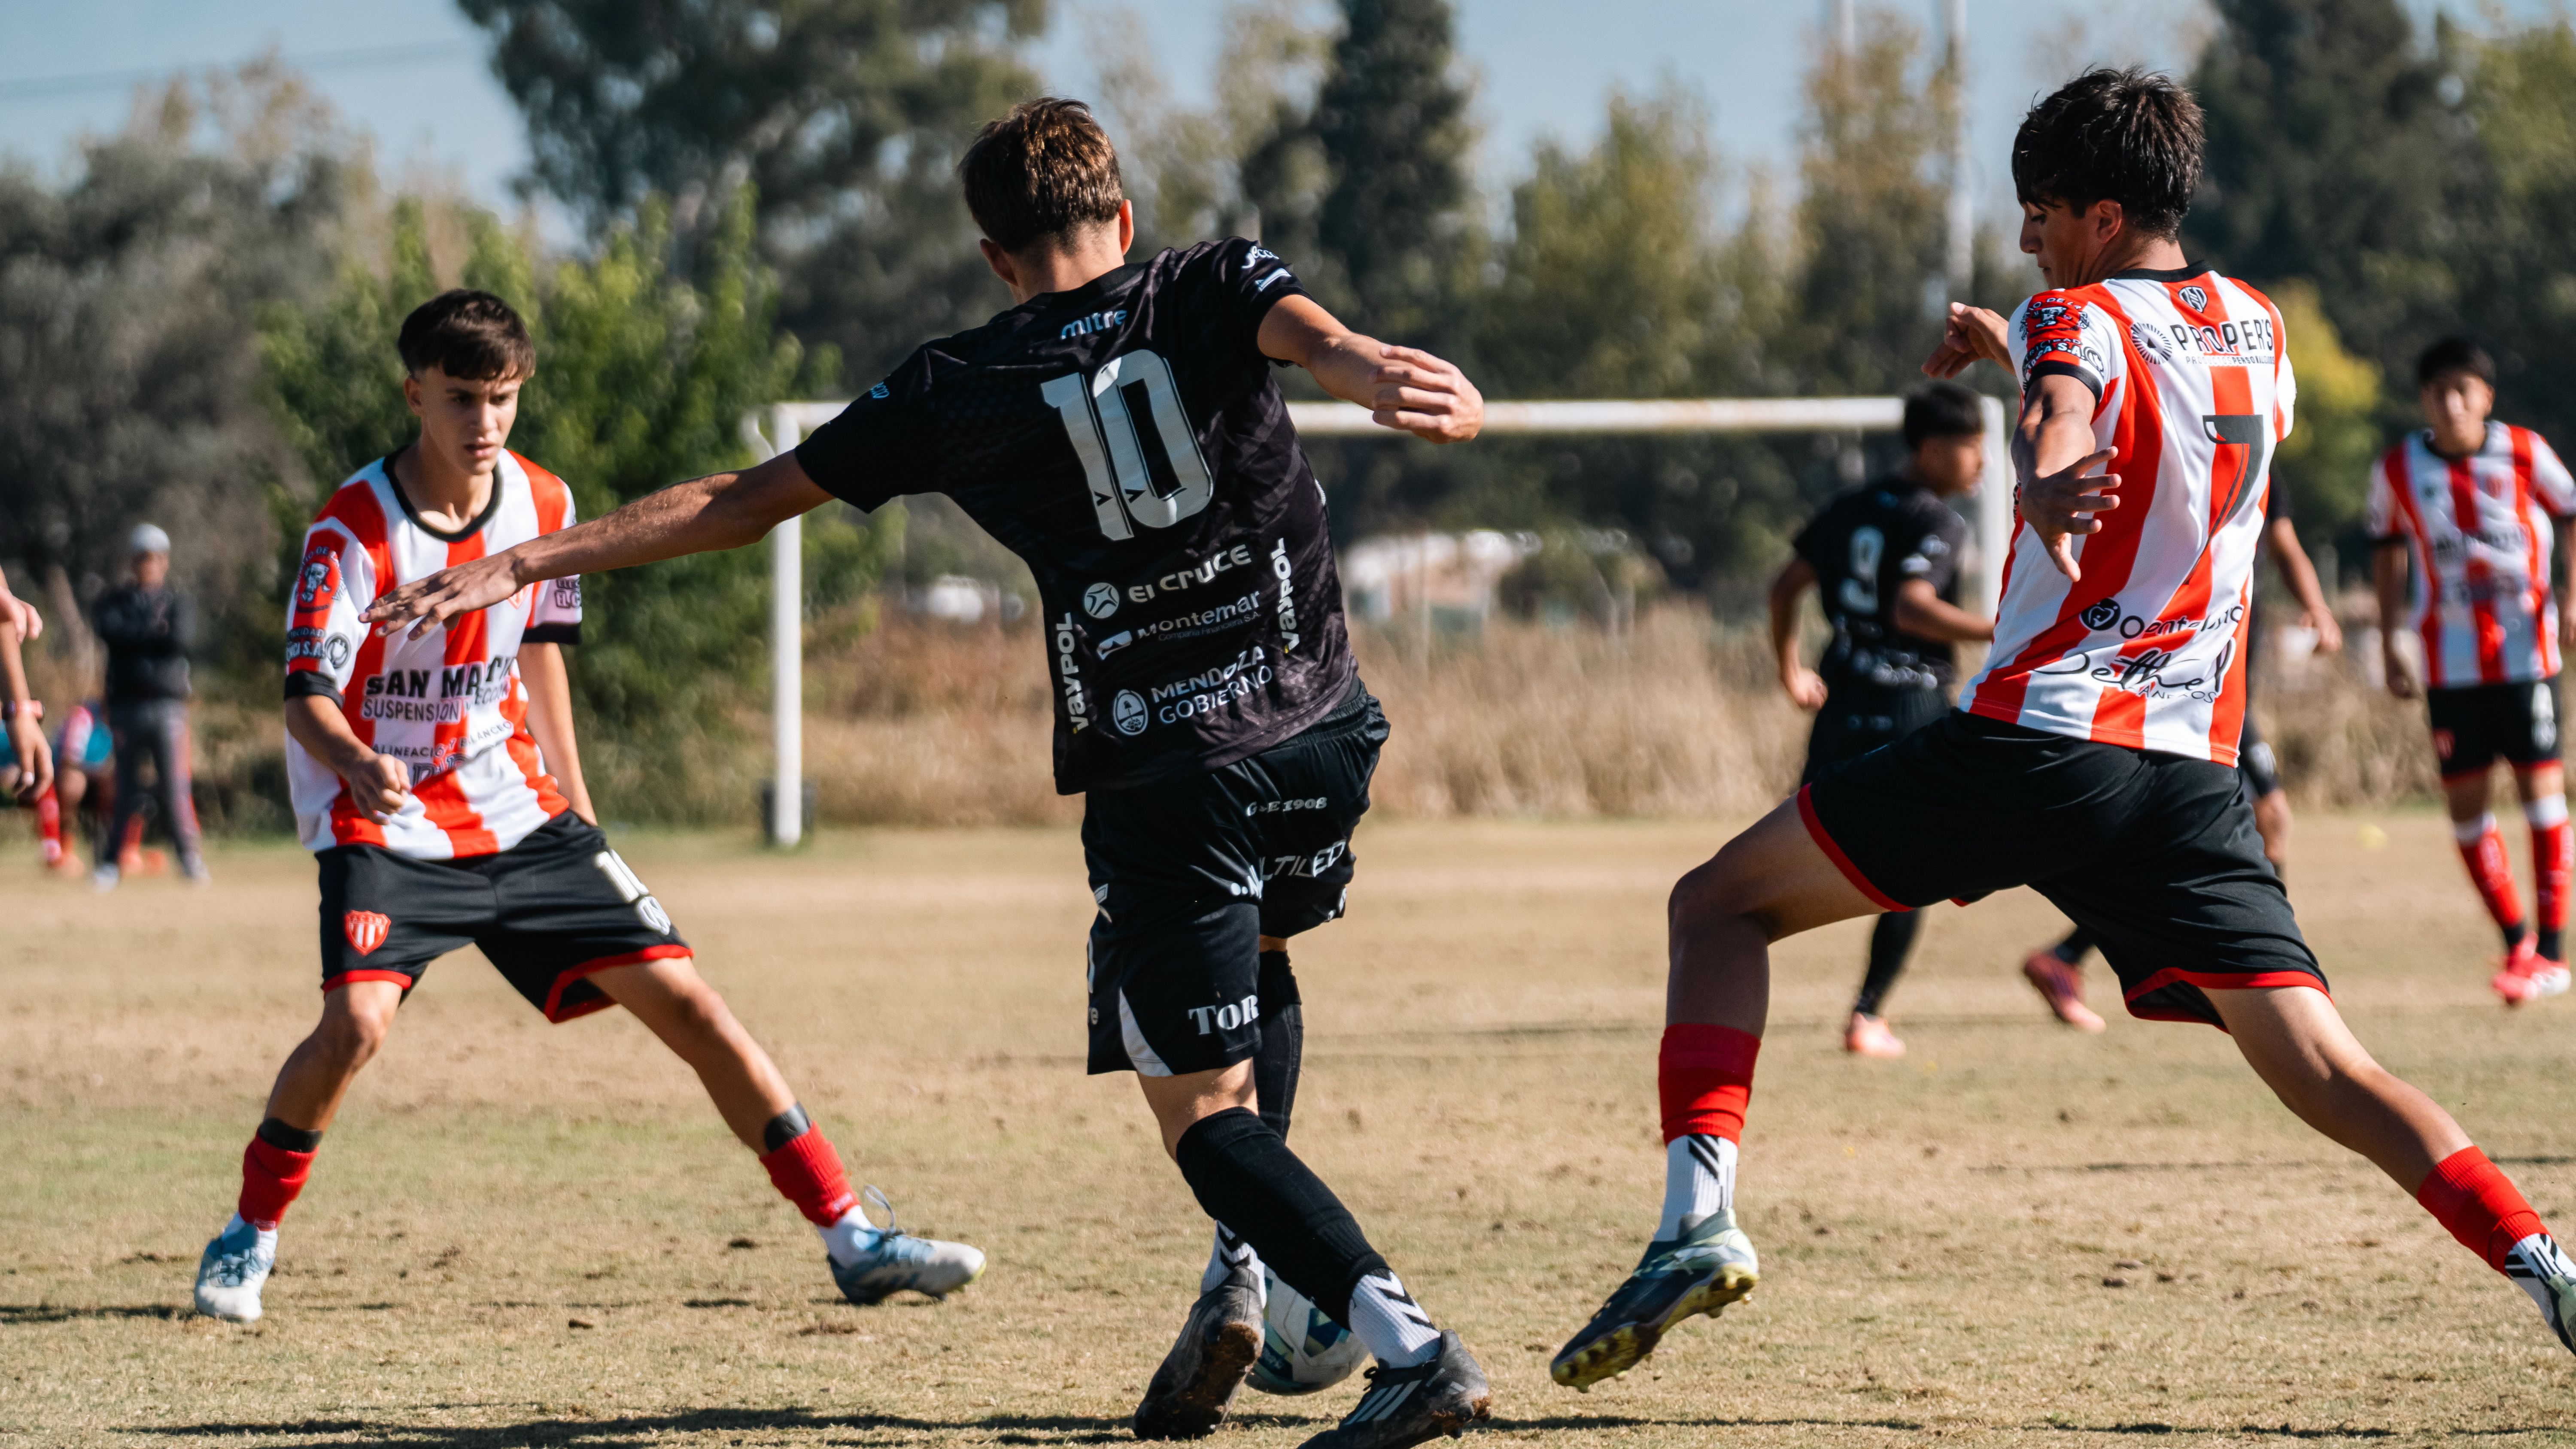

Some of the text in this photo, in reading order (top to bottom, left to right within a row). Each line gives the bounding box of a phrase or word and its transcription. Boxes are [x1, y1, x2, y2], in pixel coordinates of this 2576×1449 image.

[1060, 309, 1127, 340] mitre
[1040, 349, 1214, 542] 10
[2184, 414, 2264, 584] 7
[1838, 524, 1885, 614] 9
[366, 669, 430, 699] SAN
[1151, 646, 1265, 703] MENDOZA
[1160, 665, 1272, 724] GOBIERNO
[1188, 994, 1259, 1035] TOR
